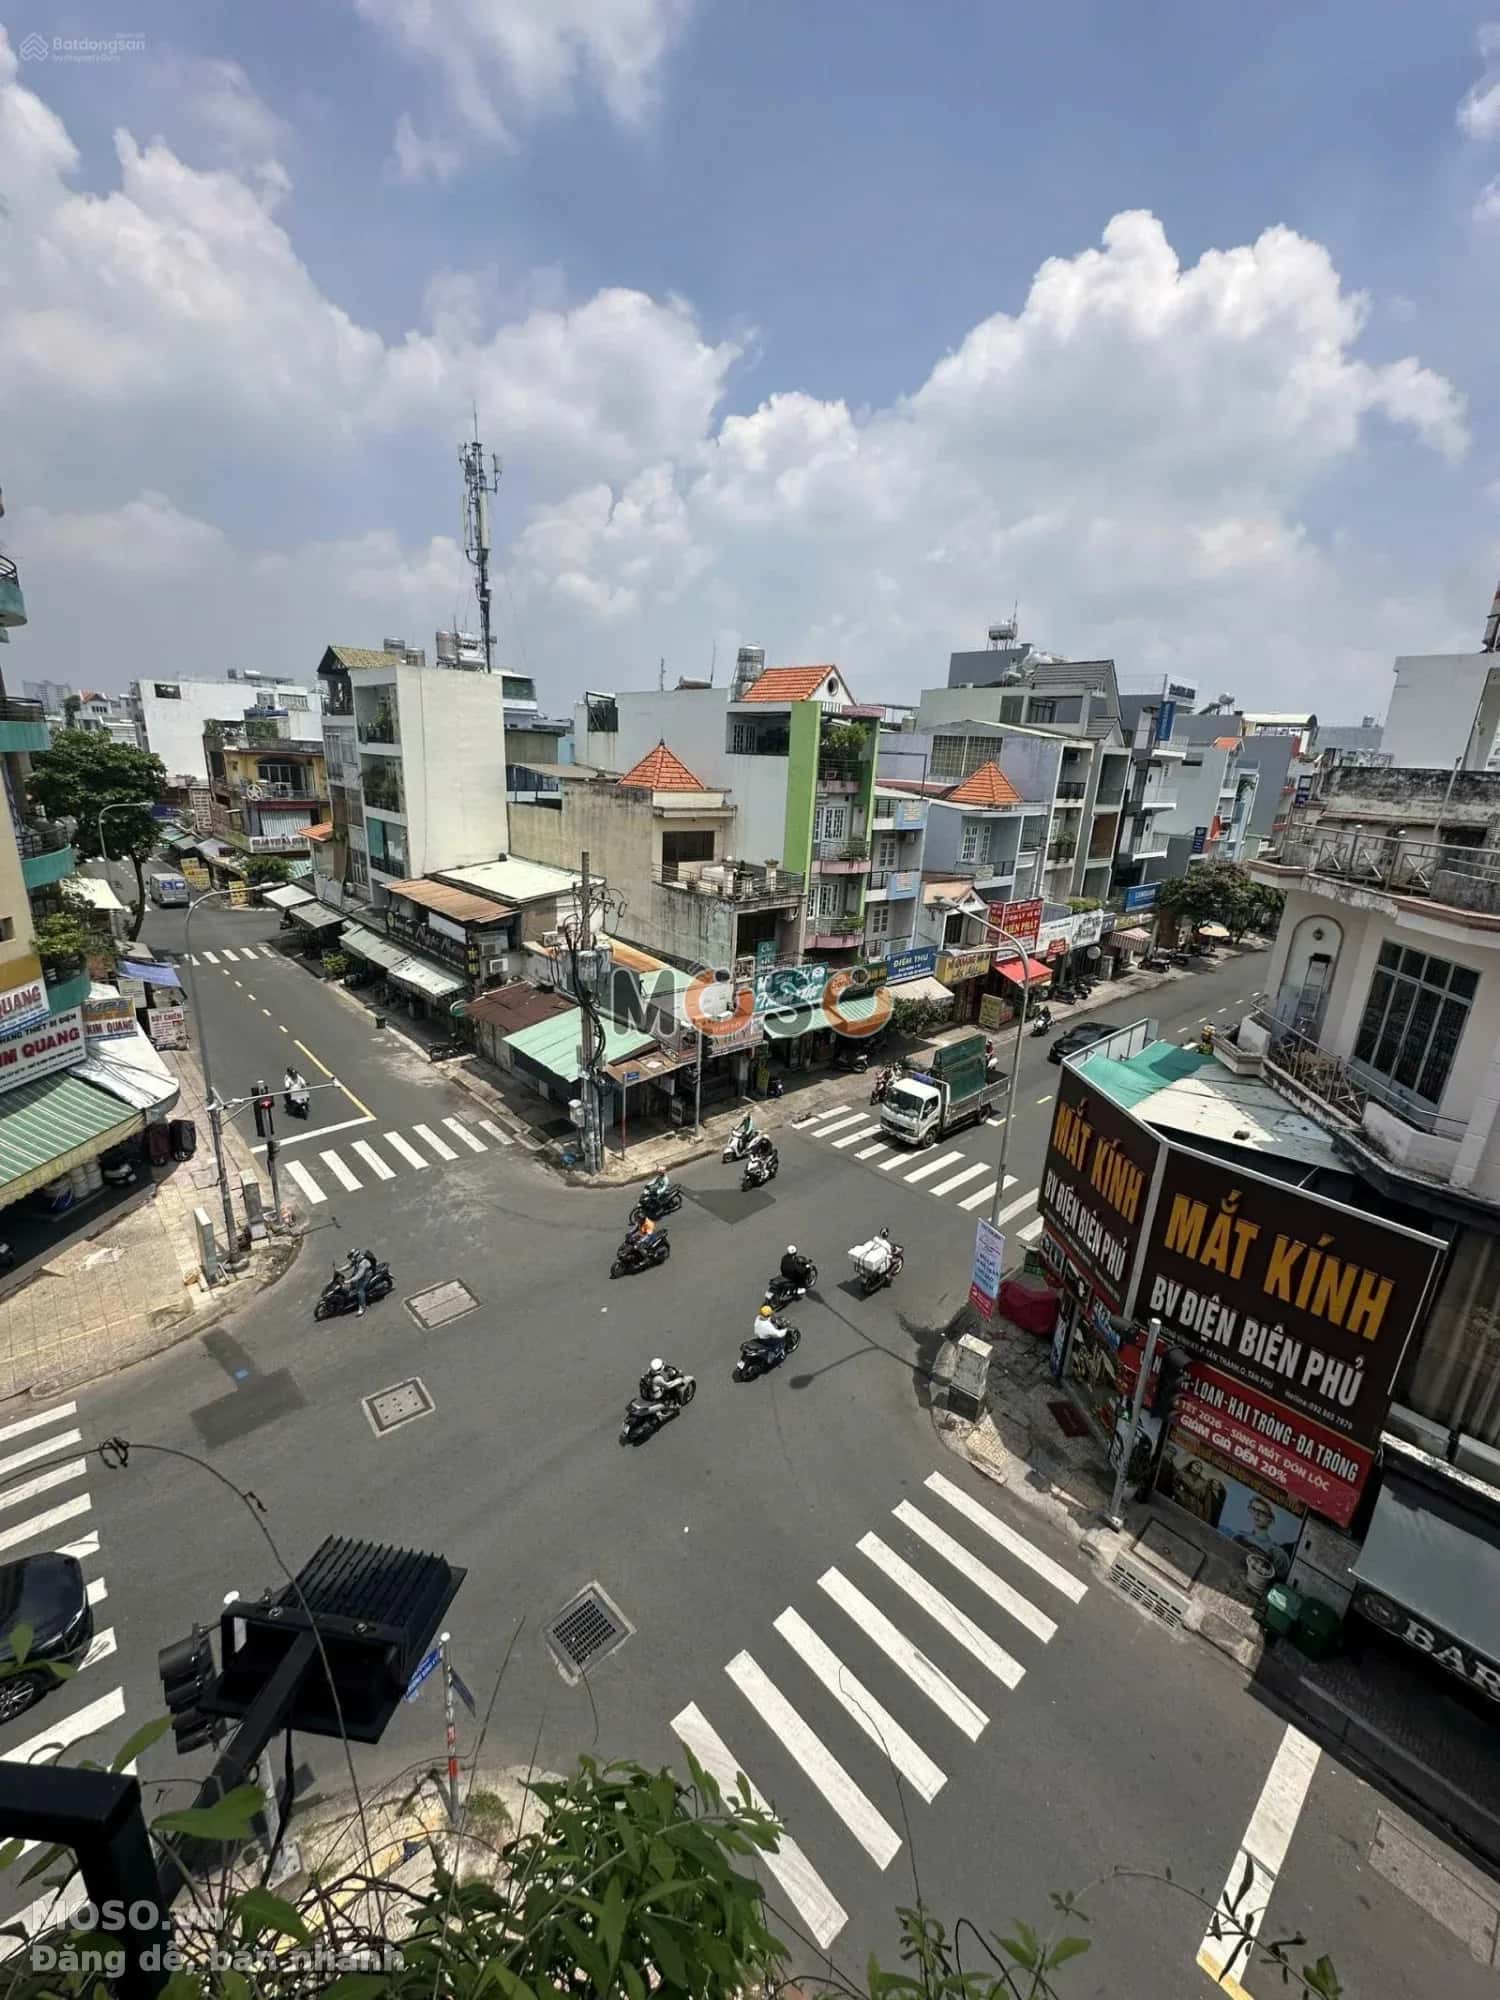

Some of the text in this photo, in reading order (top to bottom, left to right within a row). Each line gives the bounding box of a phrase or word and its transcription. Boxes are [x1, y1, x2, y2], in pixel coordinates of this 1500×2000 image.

[23, 1027, 80, 1057] QUANG
[106, 1019, 134, 1032] QUANG
[1052, 1098, 1095, 1172] MẮT
[1090, 1138, 1146, 1225] KÍNH
[1044, 1168, 1058, 1204] BV
[1077, 1202, 1103, 1258] BIÊN
[1164, 1189, 1261, 1280] MẮT
[1263, 1233, 1396, 1342] KÍNH
[1150, 1273, 1184, 1318] BV
[1179, 1289, 1239, 1347] ĐIỆN
[1238, 1317, 1304, 1379] BIÊN
[1302, 1349, 1365, 1407] PHỦ
[1199, 1409, 1222, 1428] 2026
[1260, 1460, 1288, 1484] 20%
